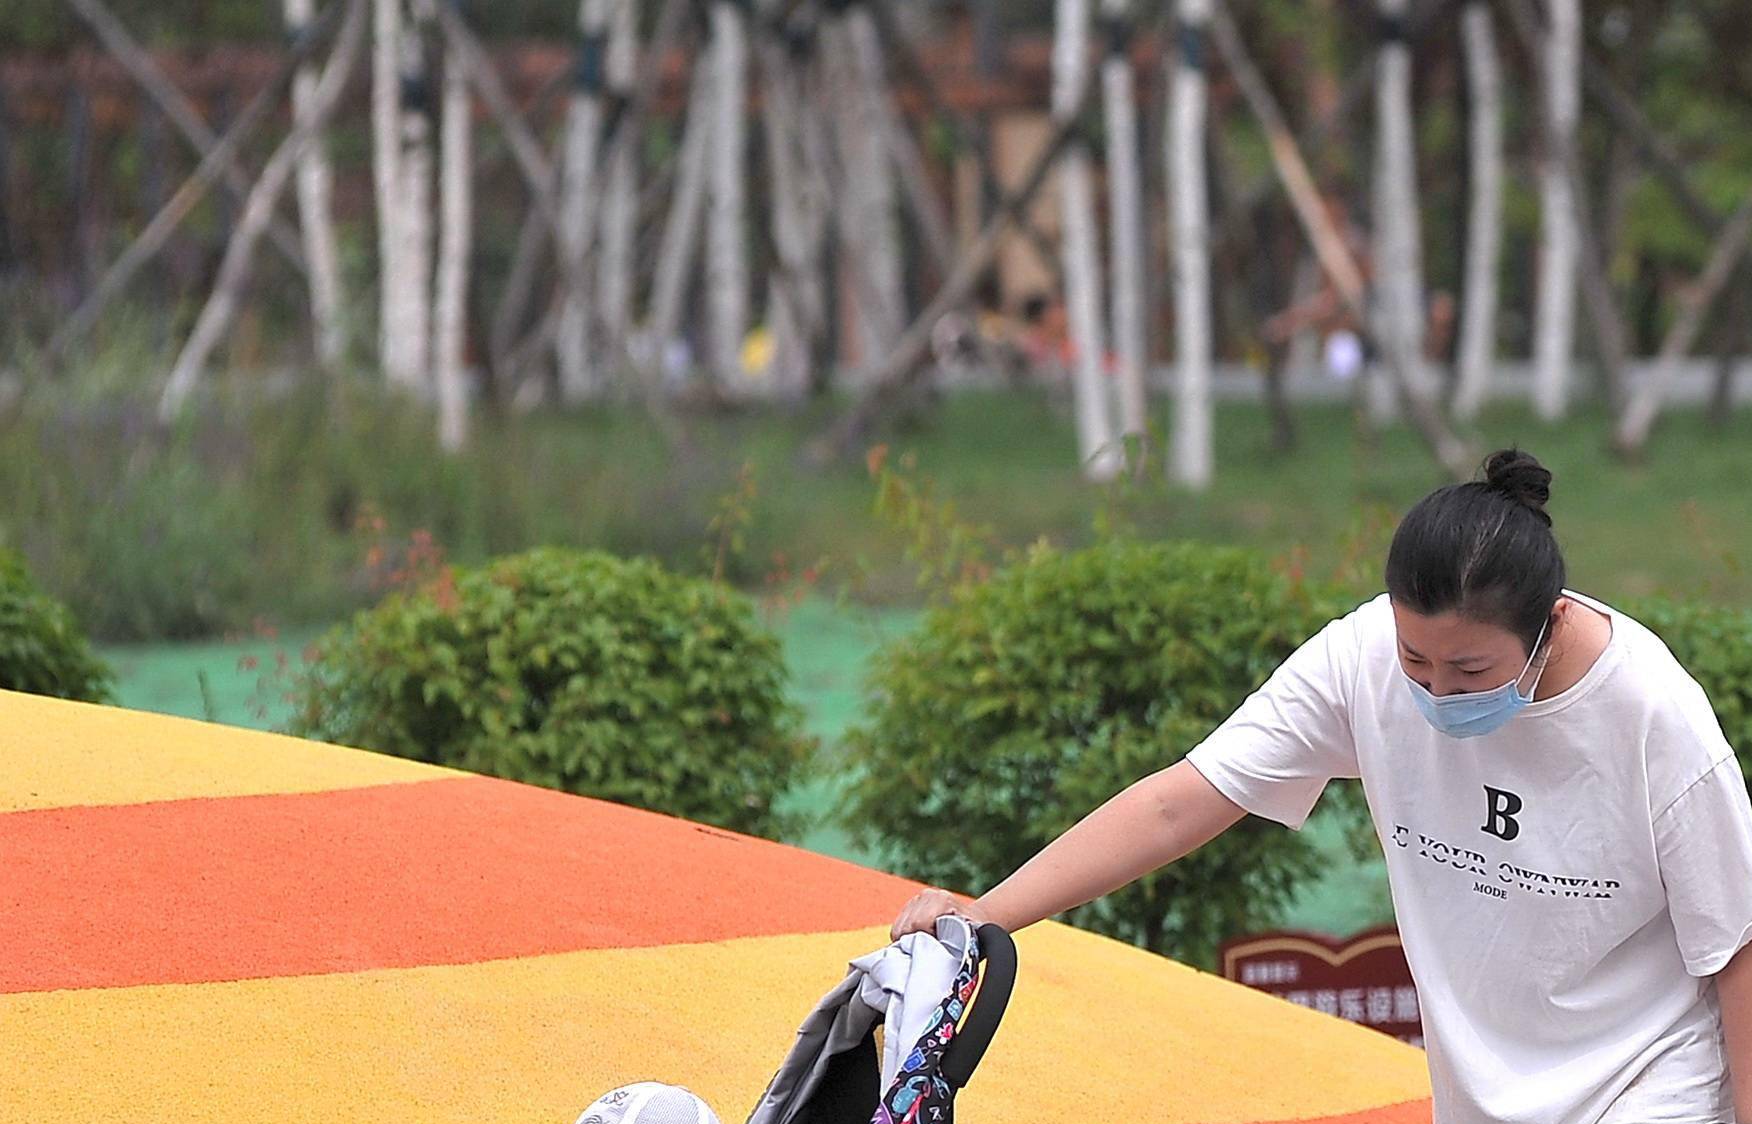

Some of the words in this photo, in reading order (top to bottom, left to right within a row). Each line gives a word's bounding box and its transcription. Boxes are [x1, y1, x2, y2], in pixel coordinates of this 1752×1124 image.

[1480, 784, 1523, 841] B
[1418, 834, 1487, 876] YOUR
[1472, 881, 1508, 900] MODE
